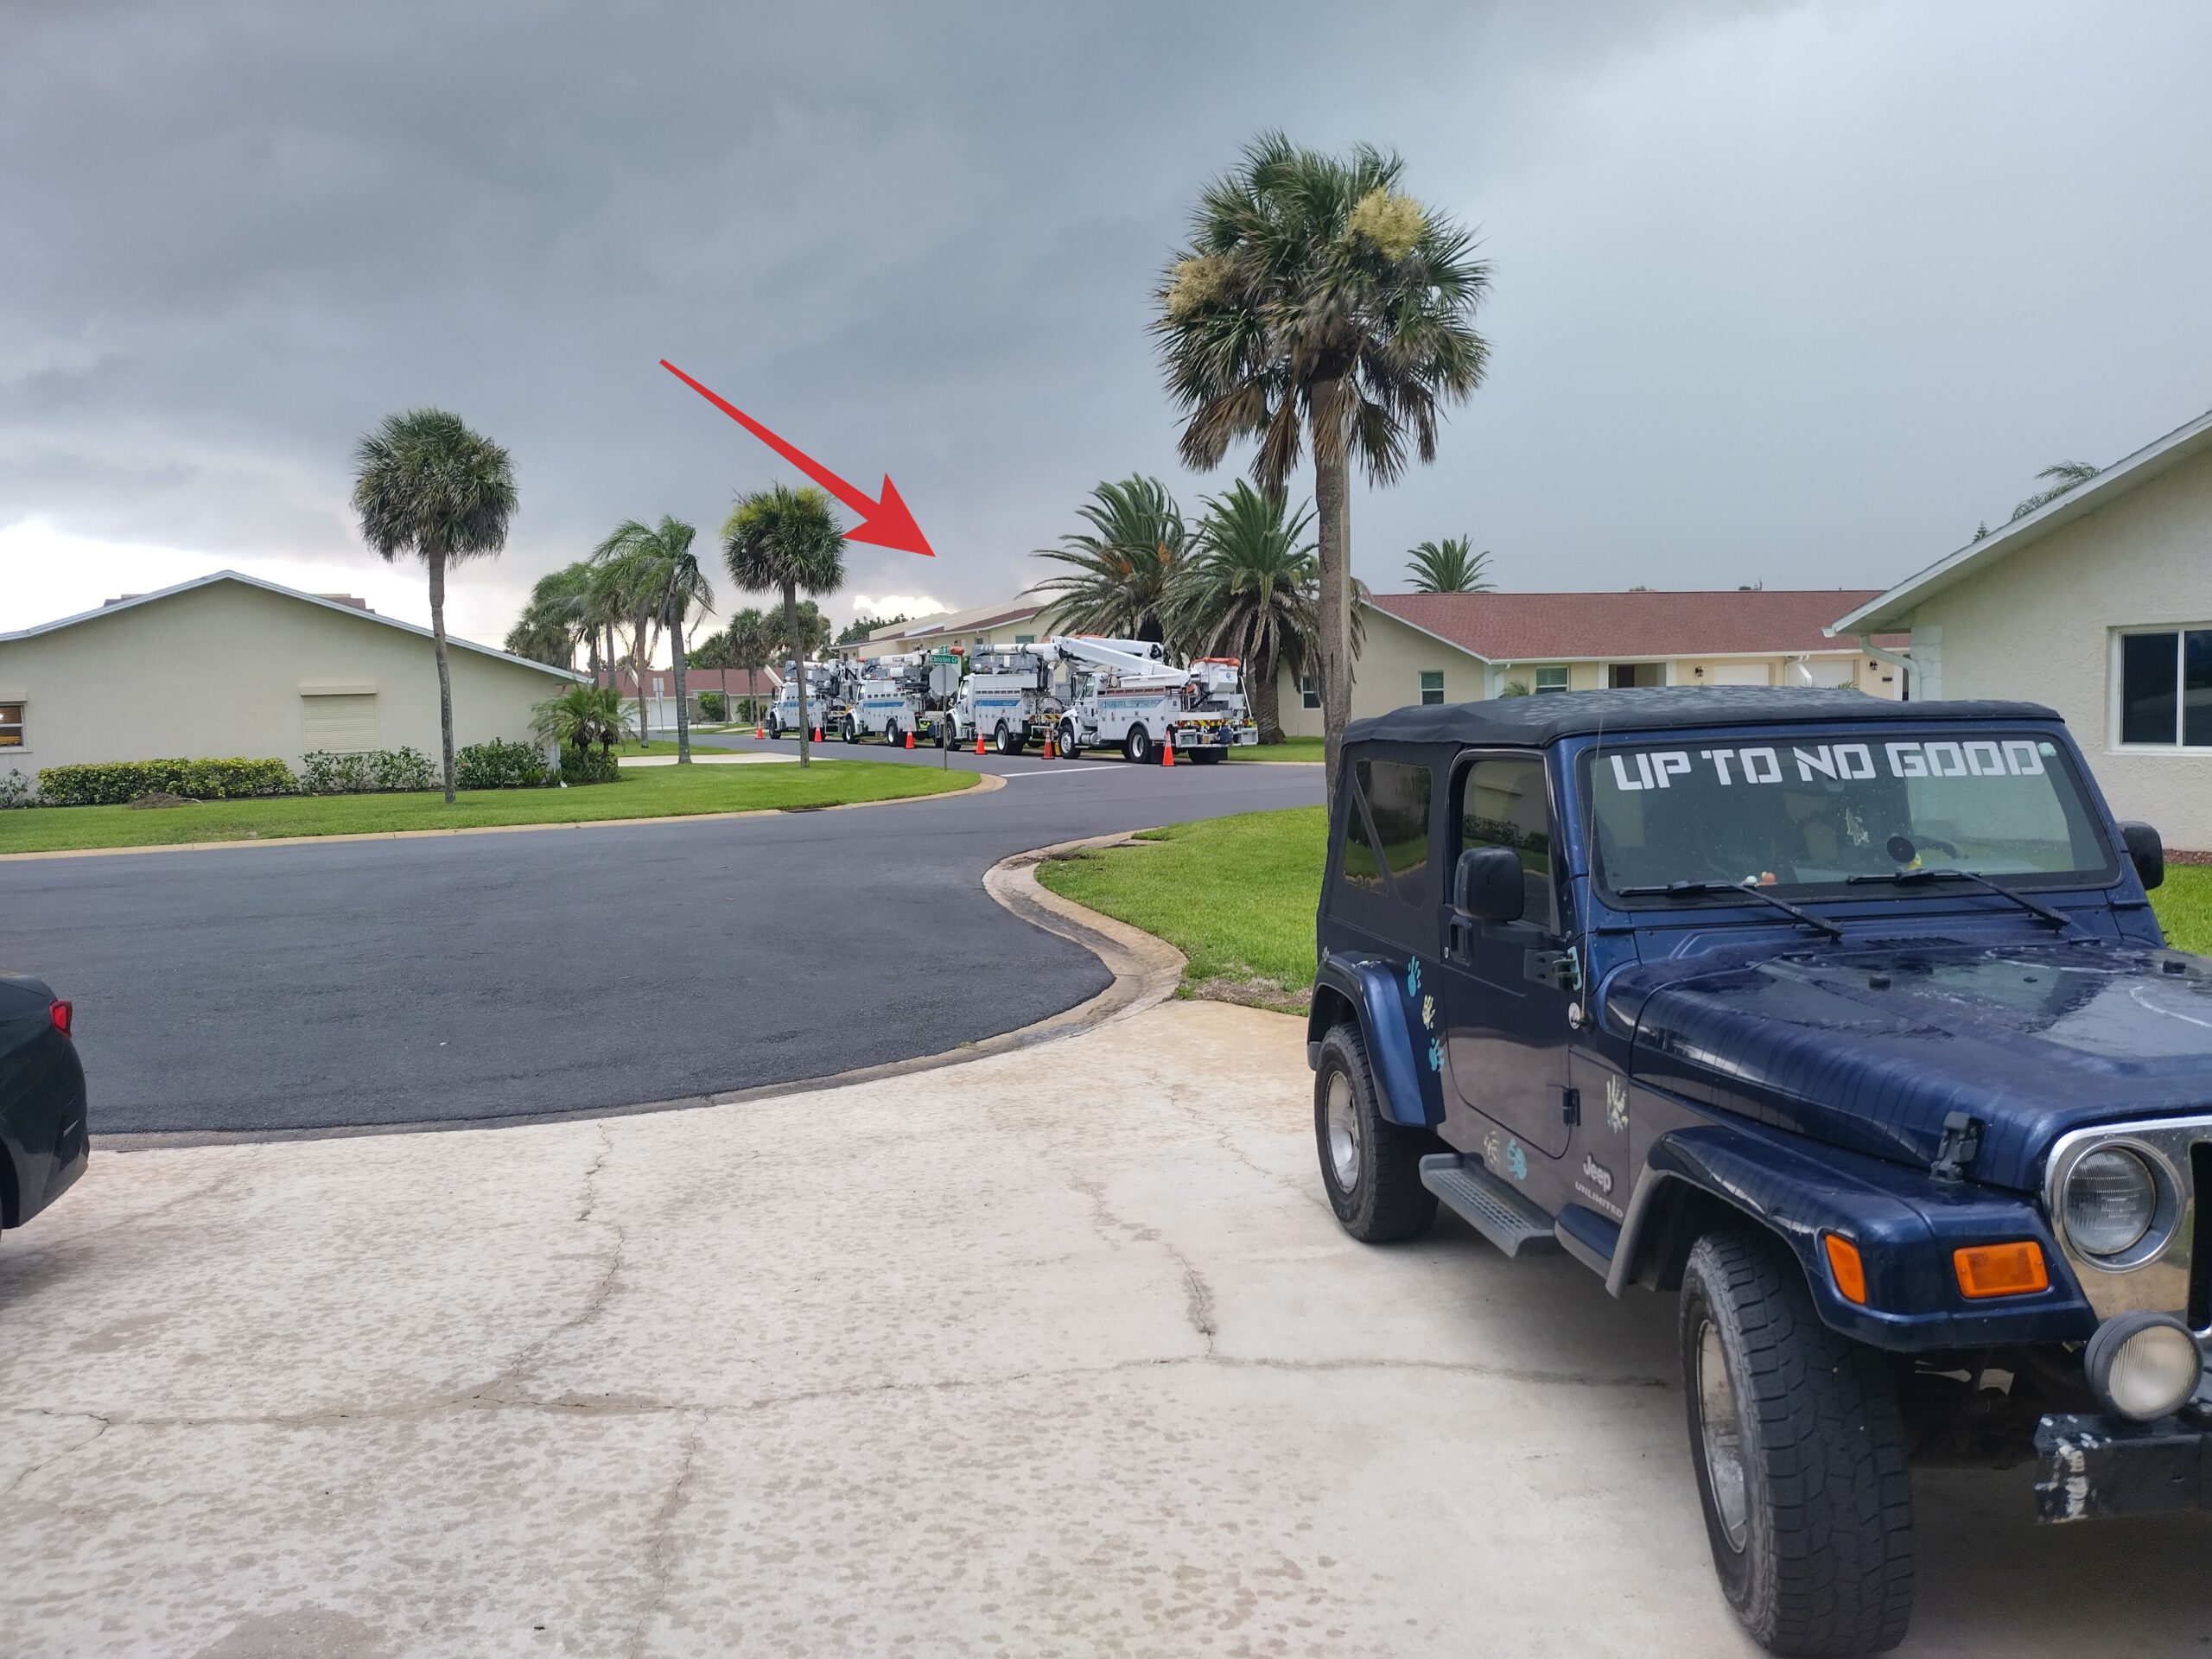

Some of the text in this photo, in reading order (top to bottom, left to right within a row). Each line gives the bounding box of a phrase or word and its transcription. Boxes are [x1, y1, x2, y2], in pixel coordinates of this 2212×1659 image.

[1611, 741, 2044, 791] UP TO NO GOOD
[1583, 1154, 1612, 1193] Jeep
[1575, 1180, 1623, 1217] UNLIMITED
